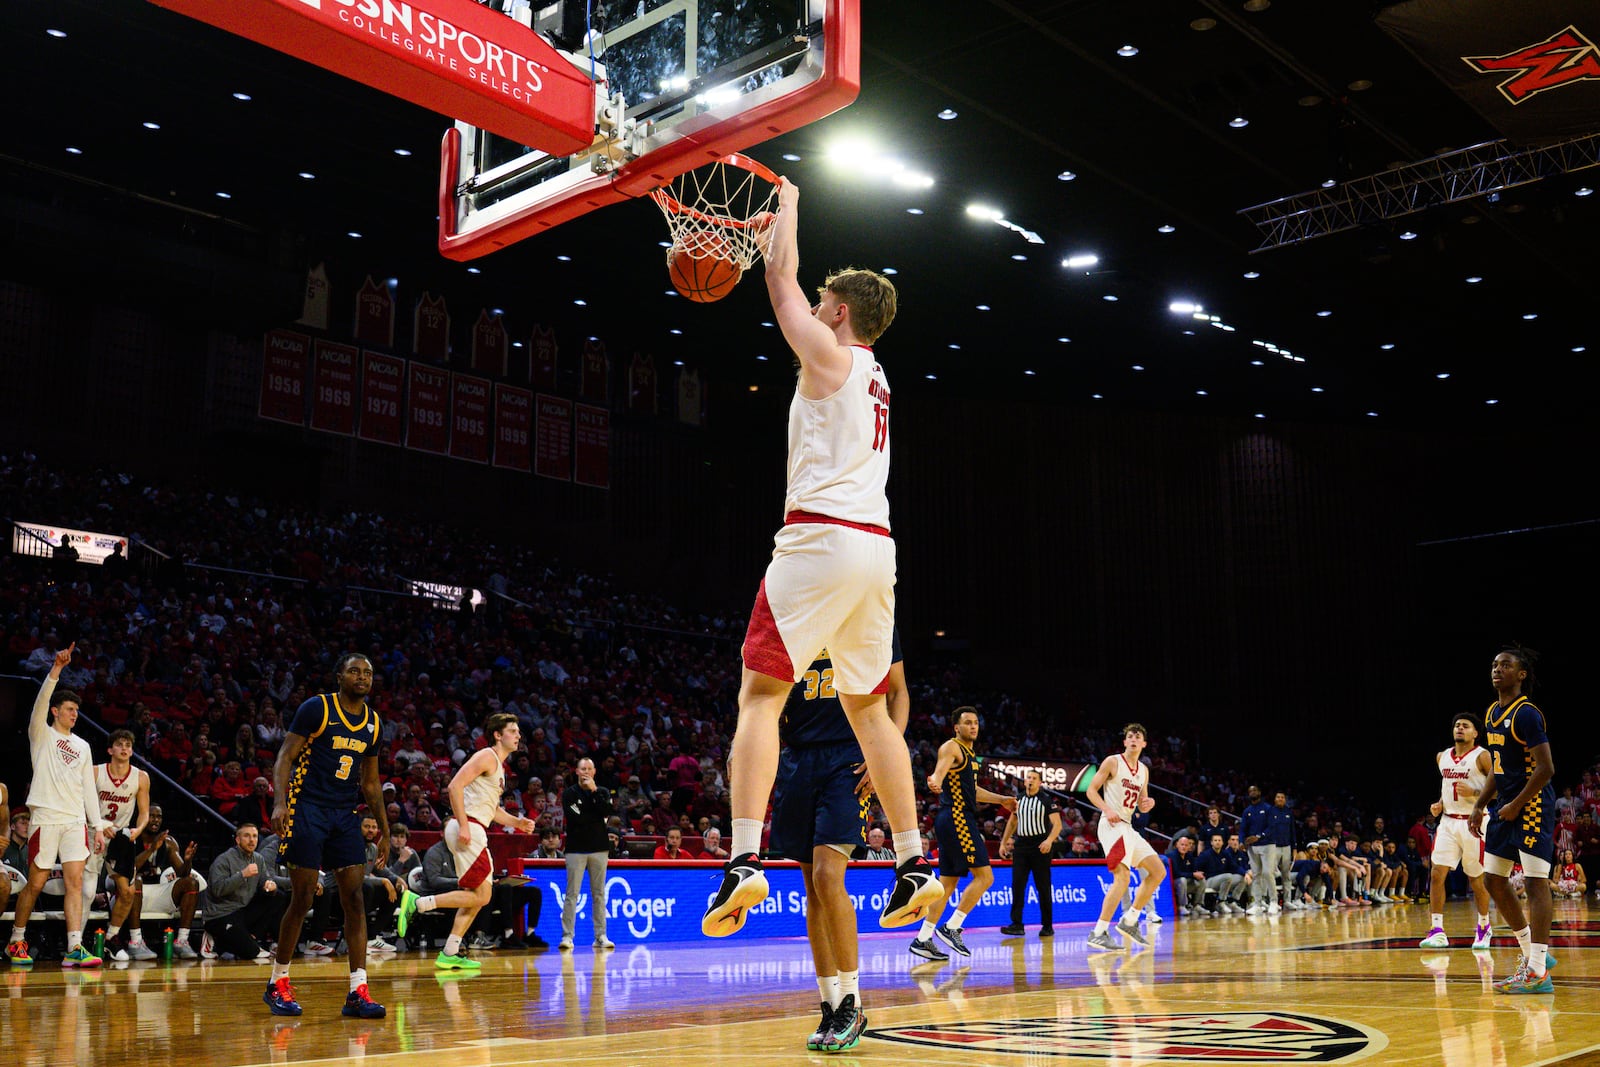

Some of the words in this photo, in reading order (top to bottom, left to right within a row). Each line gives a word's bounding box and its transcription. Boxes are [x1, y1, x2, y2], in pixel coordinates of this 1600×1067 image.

[335, 0, 414, 36] SN
[419, 11, 544, 93] SPORTS
[338, 9, 458, 72] COLLEGIATE
[468, 66, 534, 104] SELECT
[270, 335, 304, 353] NCAA
[484, 334, 497, 348] 10
[319, 348, 353, 365] NCAA
[368, 360, 399, 377] NCAA
[267, 373, 302, 397] 1958
[415, 371, 446, 388] NIT
[319, 385, 352, 407] 1969
[457, 382, 487, 398] NCAA
[367, 396, 398, 417] 1978
[501, 392, 529, 408] NCAA
[413, 407, 443, 427] 1993
[542, 403, 568, 418] NCAA
[580, 410, 606, 427] NIT
[455, 416, 485, 436] 1995
[499, 426, 528, 446] 1999
[453, 586, 463, 596] 21
[803, 668, 837, 701] 32
[332, 735, 368, 754] TOLEDO
[335, 754, 354, 781] 3
[1441, 768, 1470, 779] Miami
[98, 789, 132, 804] Miami
[1123, 789, 1138, 809] 22
[1452, 782, 1459, 801] 1
[104, 803, 119, 821] 3
[870, 888, 890, 911] of
[1027, 884, 1087, 905] Aletics
